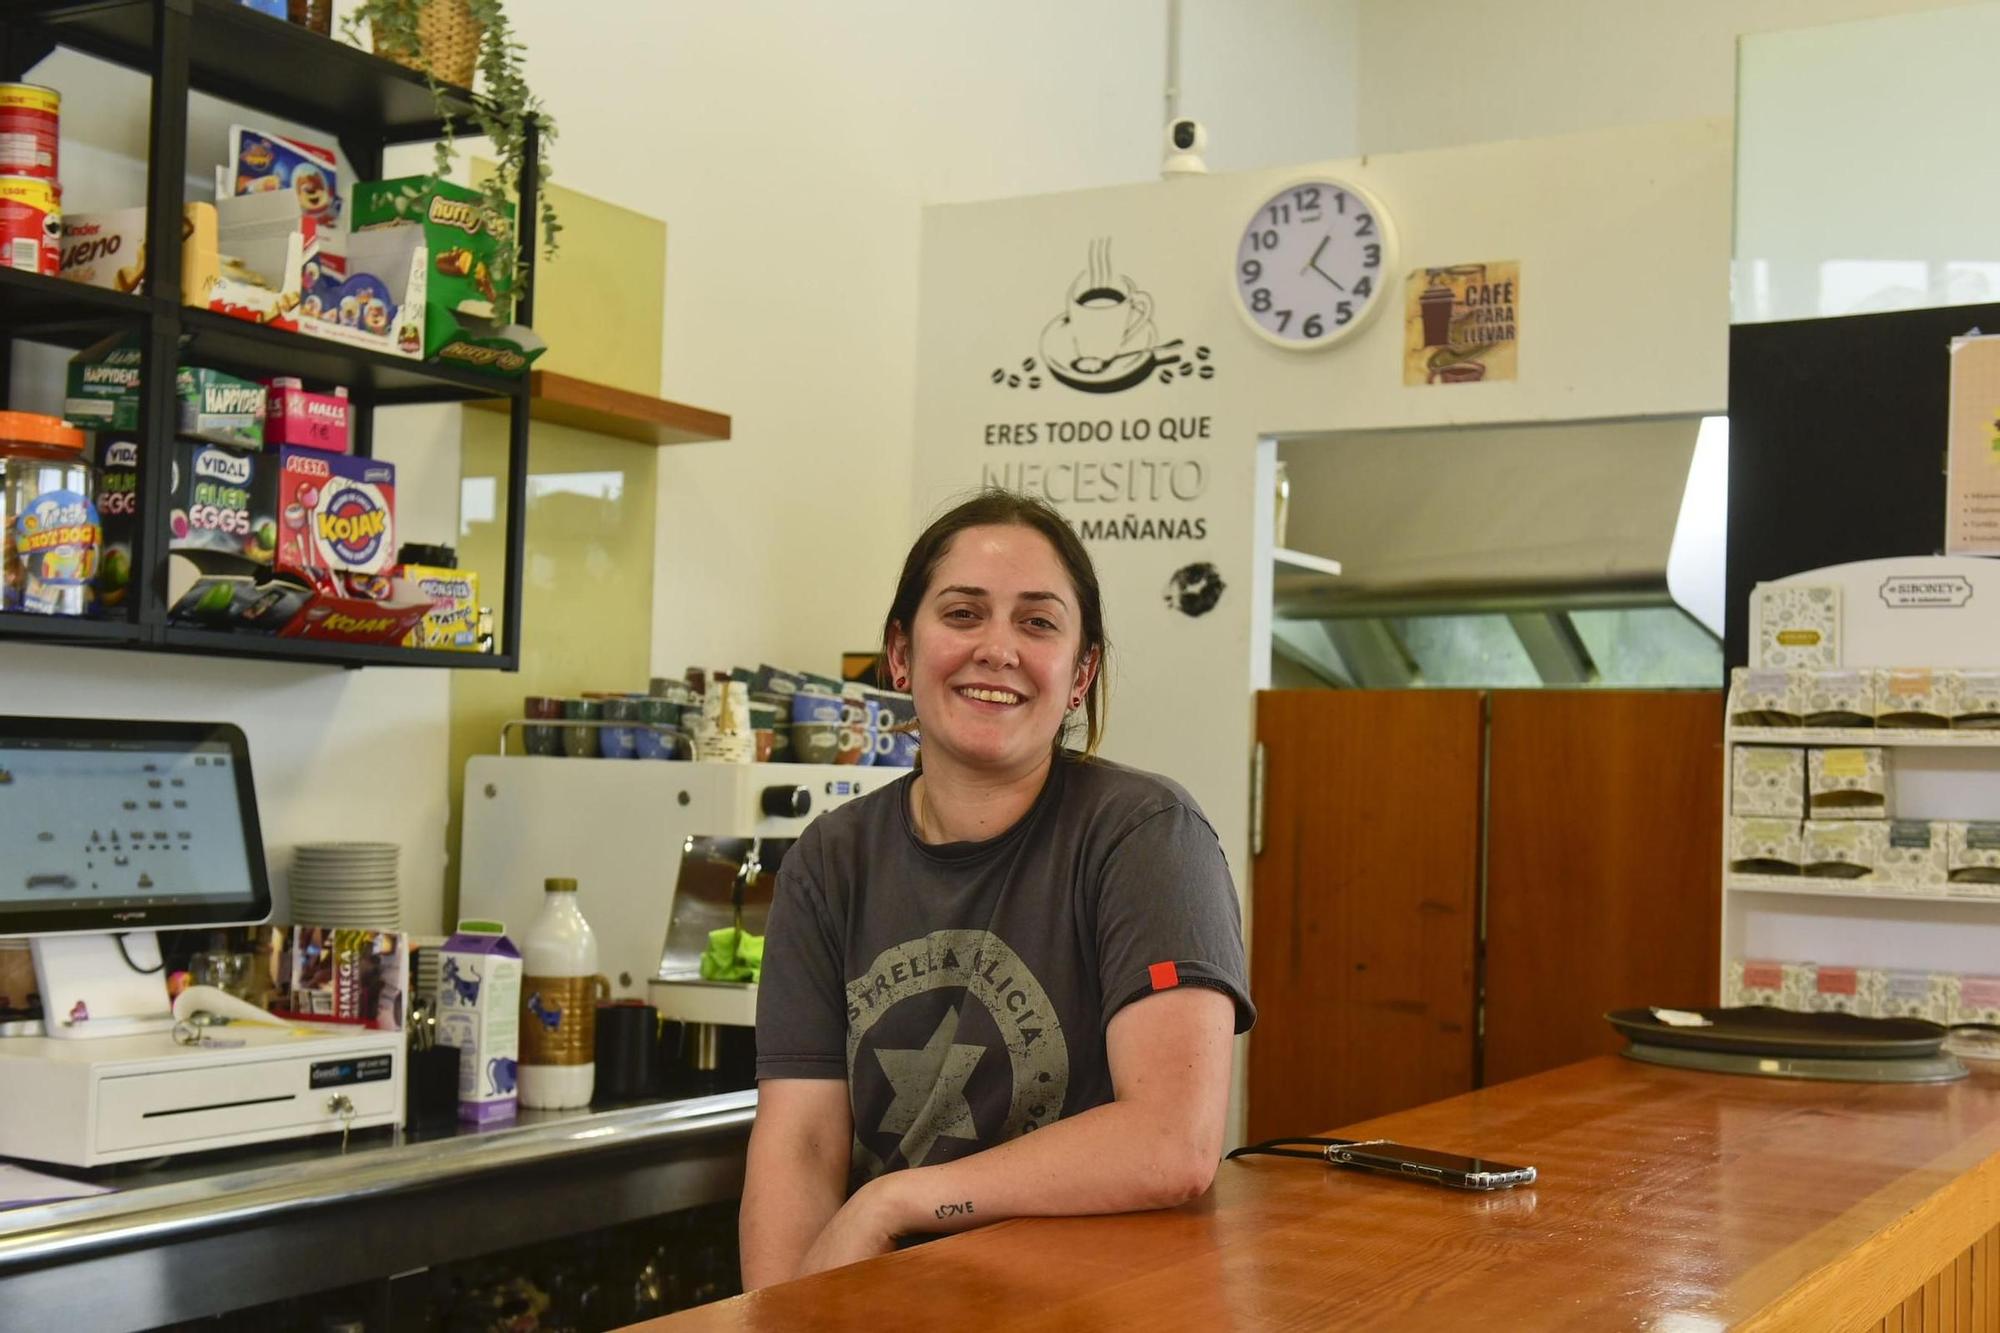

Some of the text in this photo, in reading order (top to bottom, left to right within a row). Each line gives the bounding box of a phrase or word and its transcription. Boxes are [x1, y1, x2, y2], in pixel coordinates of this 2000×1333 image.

[1294, 188, 1320, 211] 12
[1334, 192, 1345, 214] 1
[1268, 204, 1290, 225] 11
[1354, 213, 1373, 237] 2
[1250, 229, 1279, 251] 10
[60, 234, 122, 271] ueno
[1363, 243, 1381, 268] 3
[1242, 259, 1262, 285] 9
[1352, 276, 1372, 298] 4
[1252, 288, 1272, 312] 8
[1275, 310, 1293, 333] 7
[1335, 300, 1354, 325] 5
[1303, 314, 1323, 338] 6
[308, 401, 344, 418] HALLS
[985, 416, 1211, 446] ERES TODO LO QUE
[110, 449, 137, 463] VID
[203, 456, 246, 477] VIDAL
[981, 455, 1206, 503] NECESITO
[100, 492, 135, 514] EGG
[189, 503, 250, 535] EGGS
[317, 508, 385, 543] KOJAK
[1081, 513, 1207, 541] MAÑANAS
[322, 613, 396, 632] KOJAK
[847, 947, 960, 1021] STRELLA
